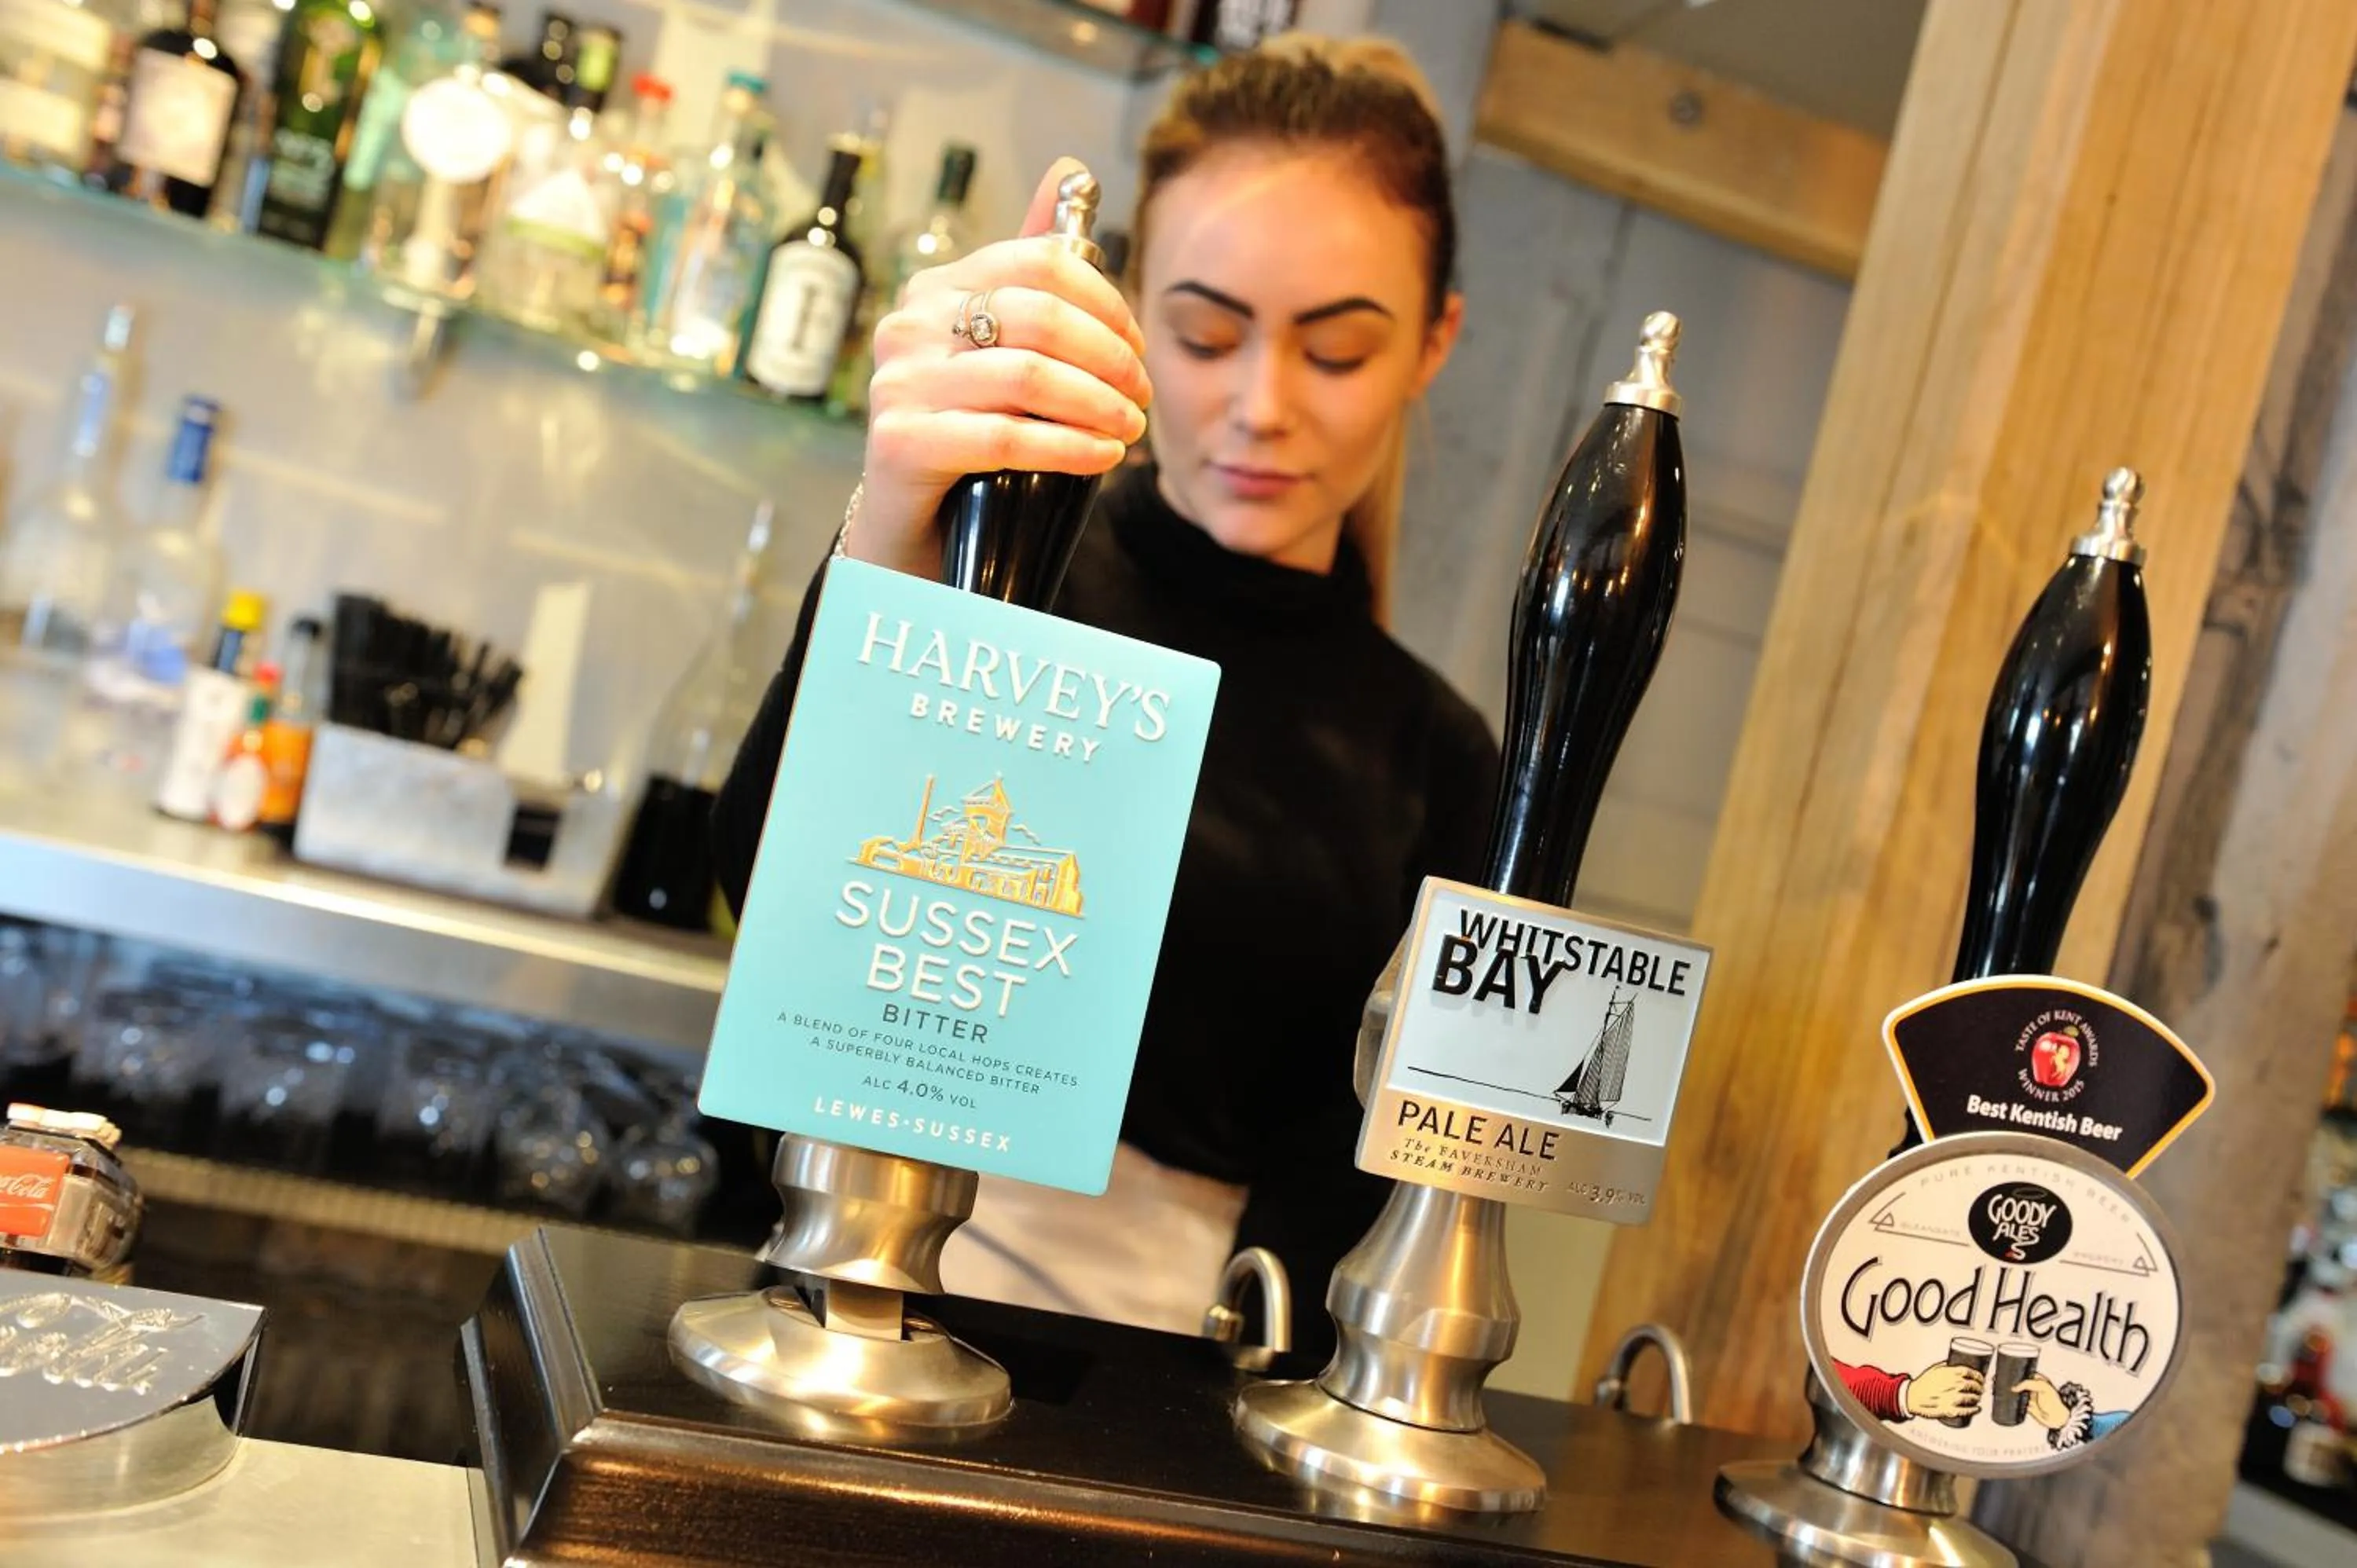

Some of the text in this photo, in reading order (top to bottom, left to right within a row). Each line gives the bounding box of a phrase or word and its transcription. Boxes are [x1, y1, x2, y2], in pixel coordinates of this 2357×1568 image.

[857, 611, 1170, 742] HARVEY'S
[910, 693, 1101, 764] BREWERY
[835, 880, 1078, 977] SUSSEX
[1461, 909, 1691, 996] WHITSTABLE
[867, 943, 1027, 1017] BEST
[1431, 934, 1567, 1014] BAY
[777, 1011, 1078, 1086] A BLEND OF FOUR LOCAL HOPS CREATES
[882, 1003, 988, 1043] BITTER
[2014, 1021, 2038, 1051] TASTE
[2036, 1011, 2051, 1026] OF
[2054, 1009, 2082, 1024] KENT
[811, 1036, 1040, 1095] A SUPERBLY BALANCED BITTER
[862, 1075, 977, 1108] ALC 4.0% VOL
[2018, 1068, 2059, 1101] WINNER
[1398, 1100, 1560, 1160] PALE ALE
[1967, 1094, 2123, 1141] Best Kentish Beer
[1391, 1149, 1549, 1192] STEAM BREWERY
[1405, 1138, 1543, 1176] The FAVERSHAM
[1920, 1165, 1971, 1188] PURE
[1987, 1165, 2076, 1188] KENTISH
[1988, 1194, 2058, 1228] GOODY
[1992, 1222, 2040, 1255] ALES
[1841, 1256, 2154, 1376] Good Health
